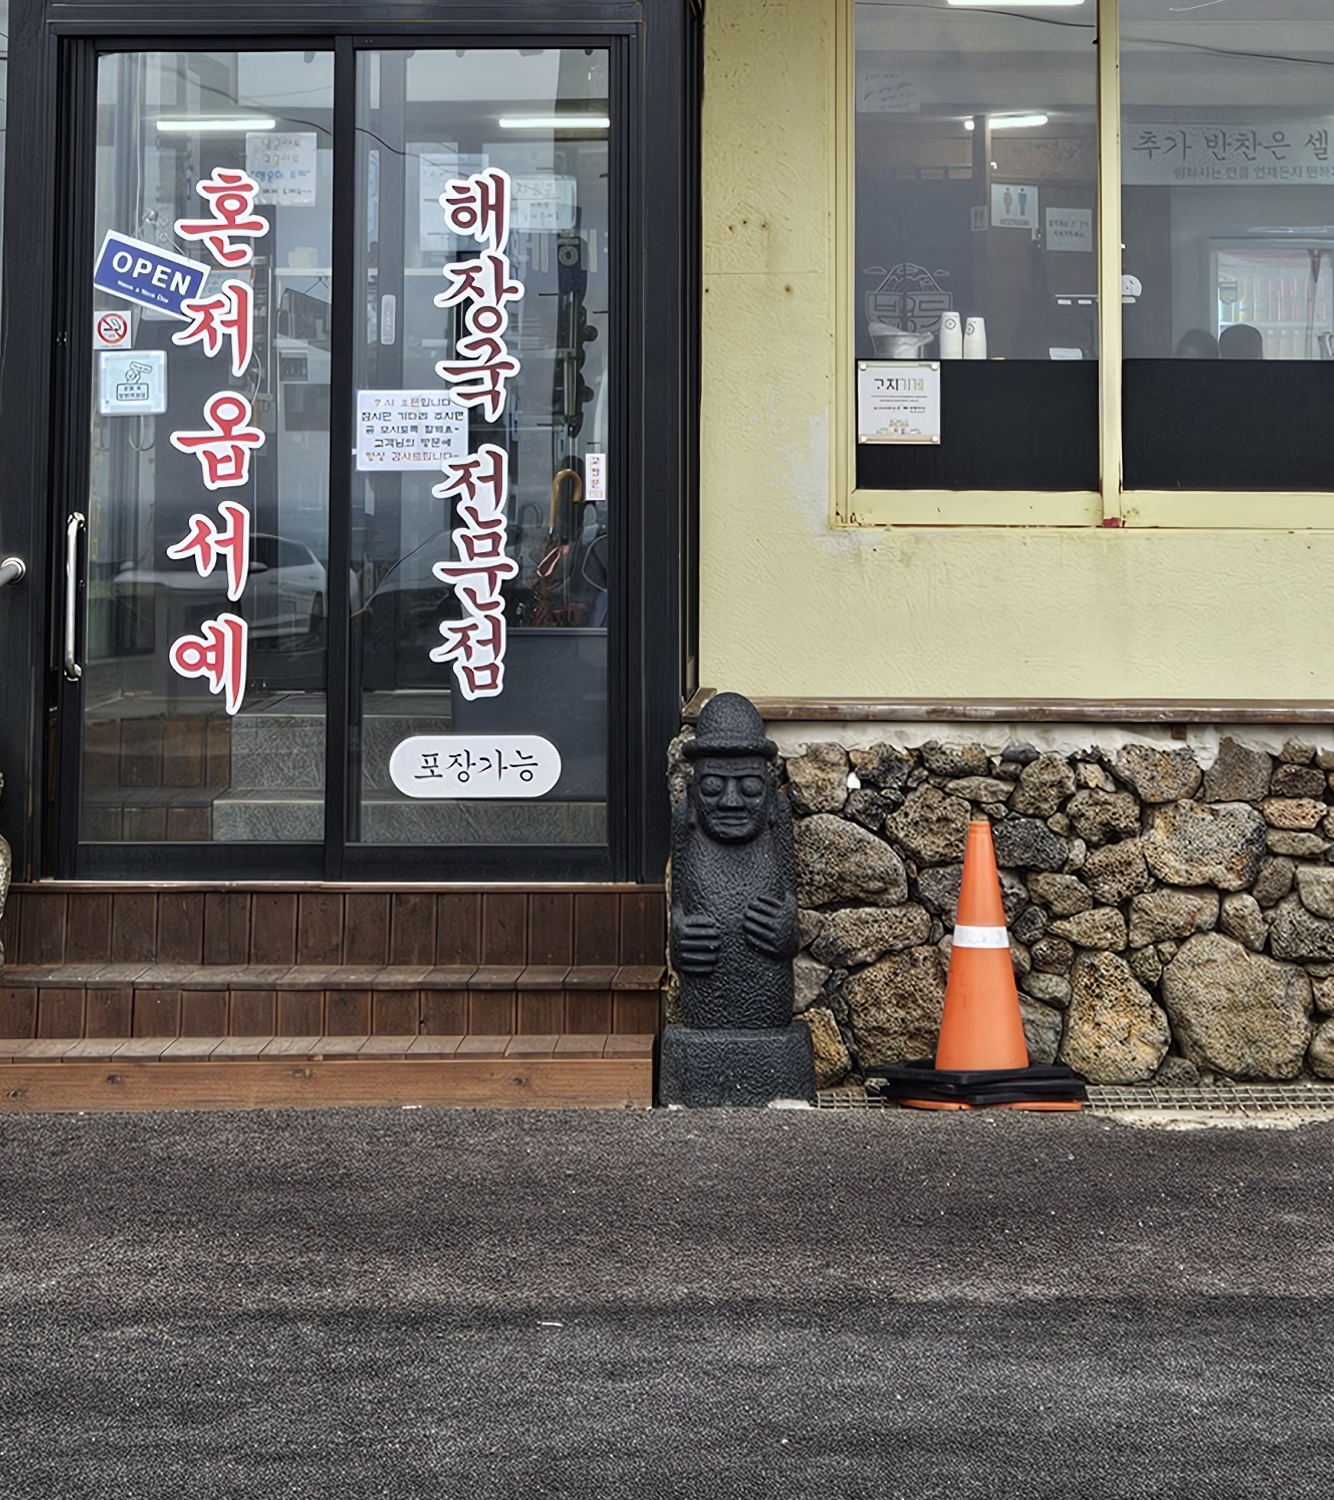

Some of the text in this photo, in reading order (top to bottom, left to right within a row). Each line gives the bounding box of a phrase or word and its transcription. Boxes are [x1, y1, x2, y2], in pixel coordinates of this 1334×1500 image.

[1132, 129, 1192, 161] 추가
[1206, 129, 1292, 161] 반찬은
[112, 251, 192, 296] OPEN
[172, 171, 265, 711] 혼저옵서예
[432, 169, 521, 699] 해장국 전문점
[413, 743, 539, 784] 포장가능
